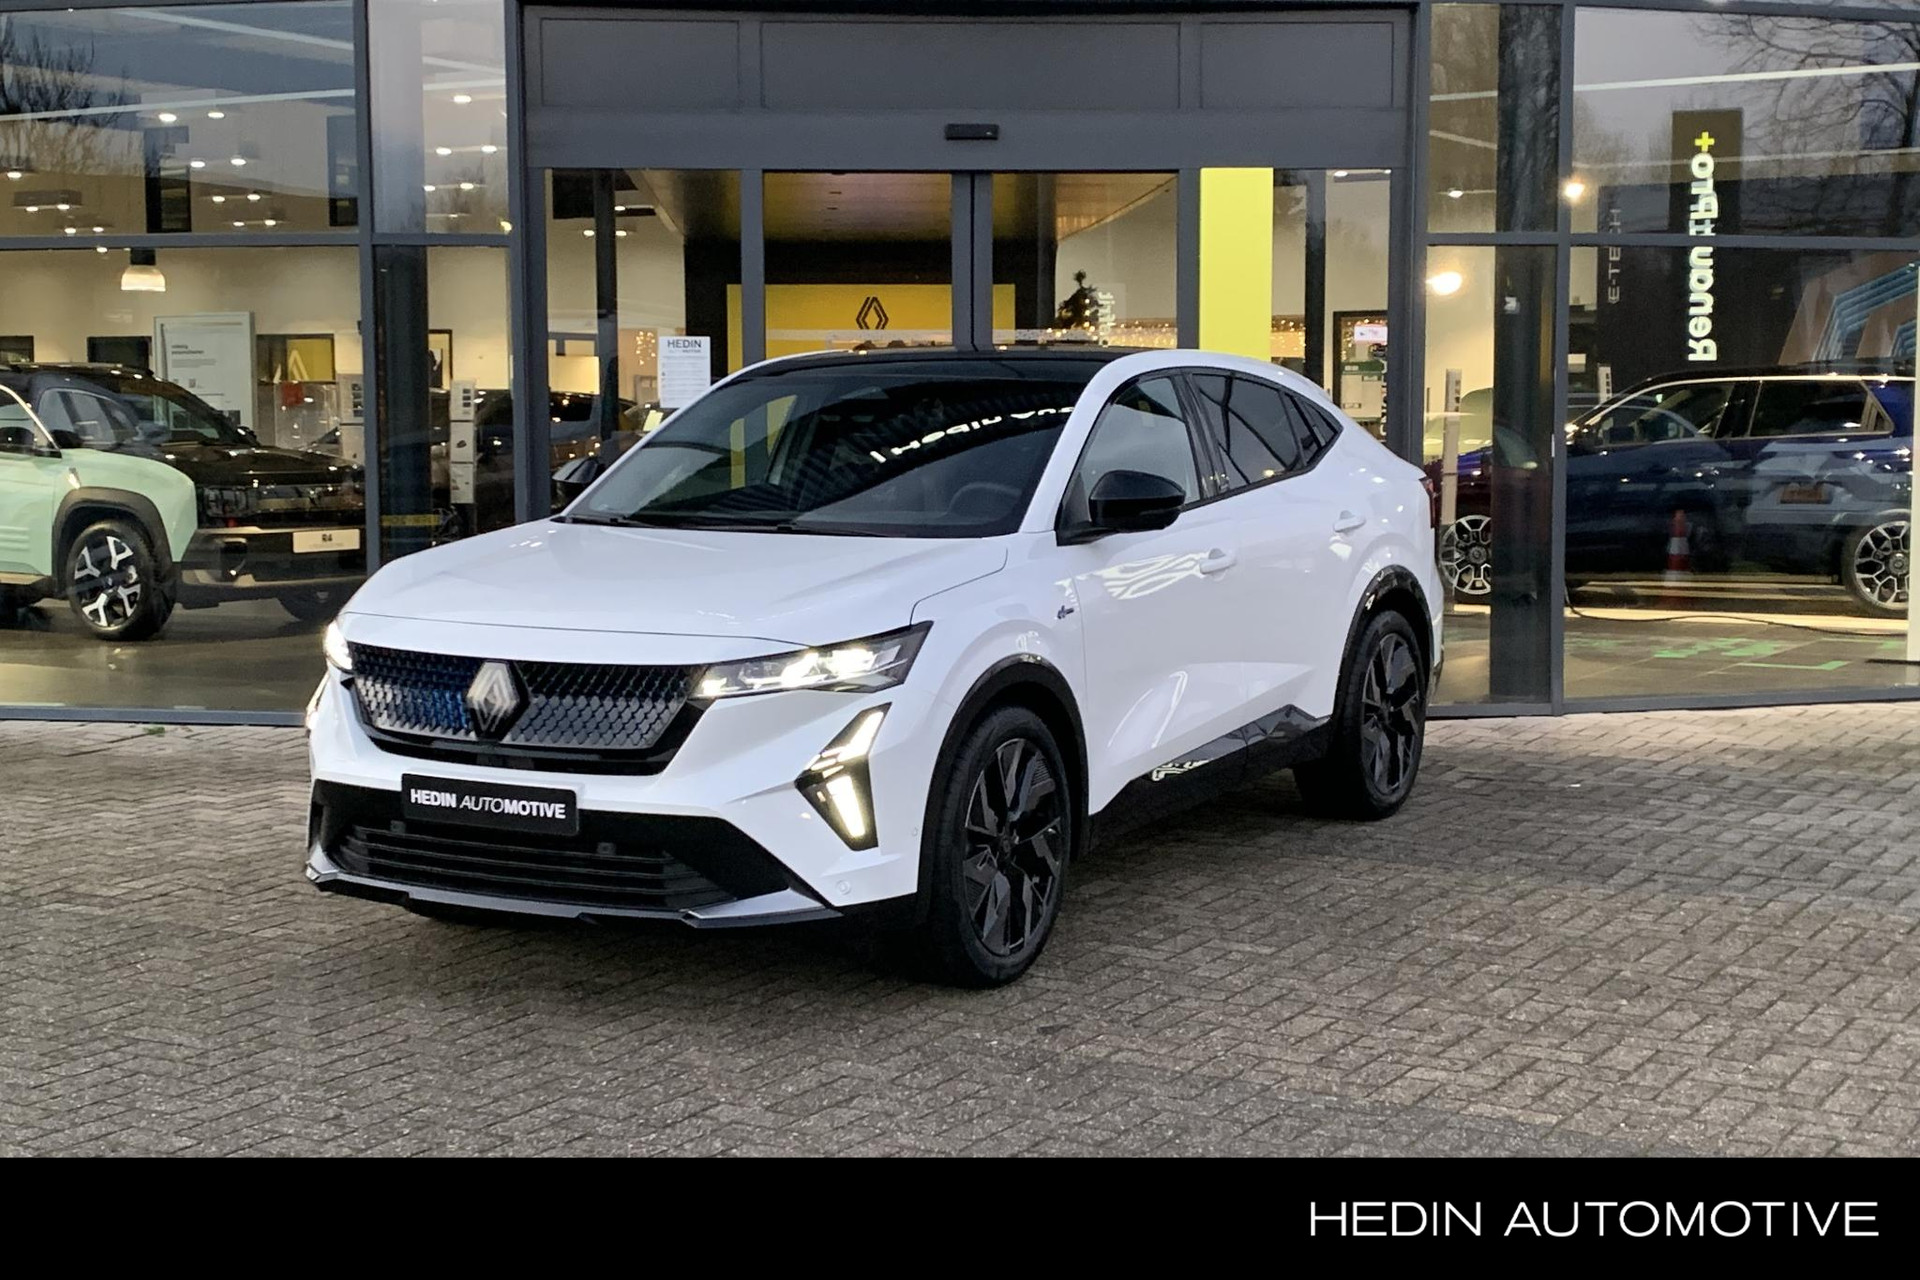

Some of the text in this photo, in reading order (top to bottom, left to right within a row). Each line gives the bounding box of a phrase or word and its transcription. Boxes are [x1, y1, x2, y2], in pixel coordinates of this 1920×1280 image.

[667, 339, 702, 348] HEDIN
[410, 788, 566, 819] HEDIN AUTOMOTIVE
